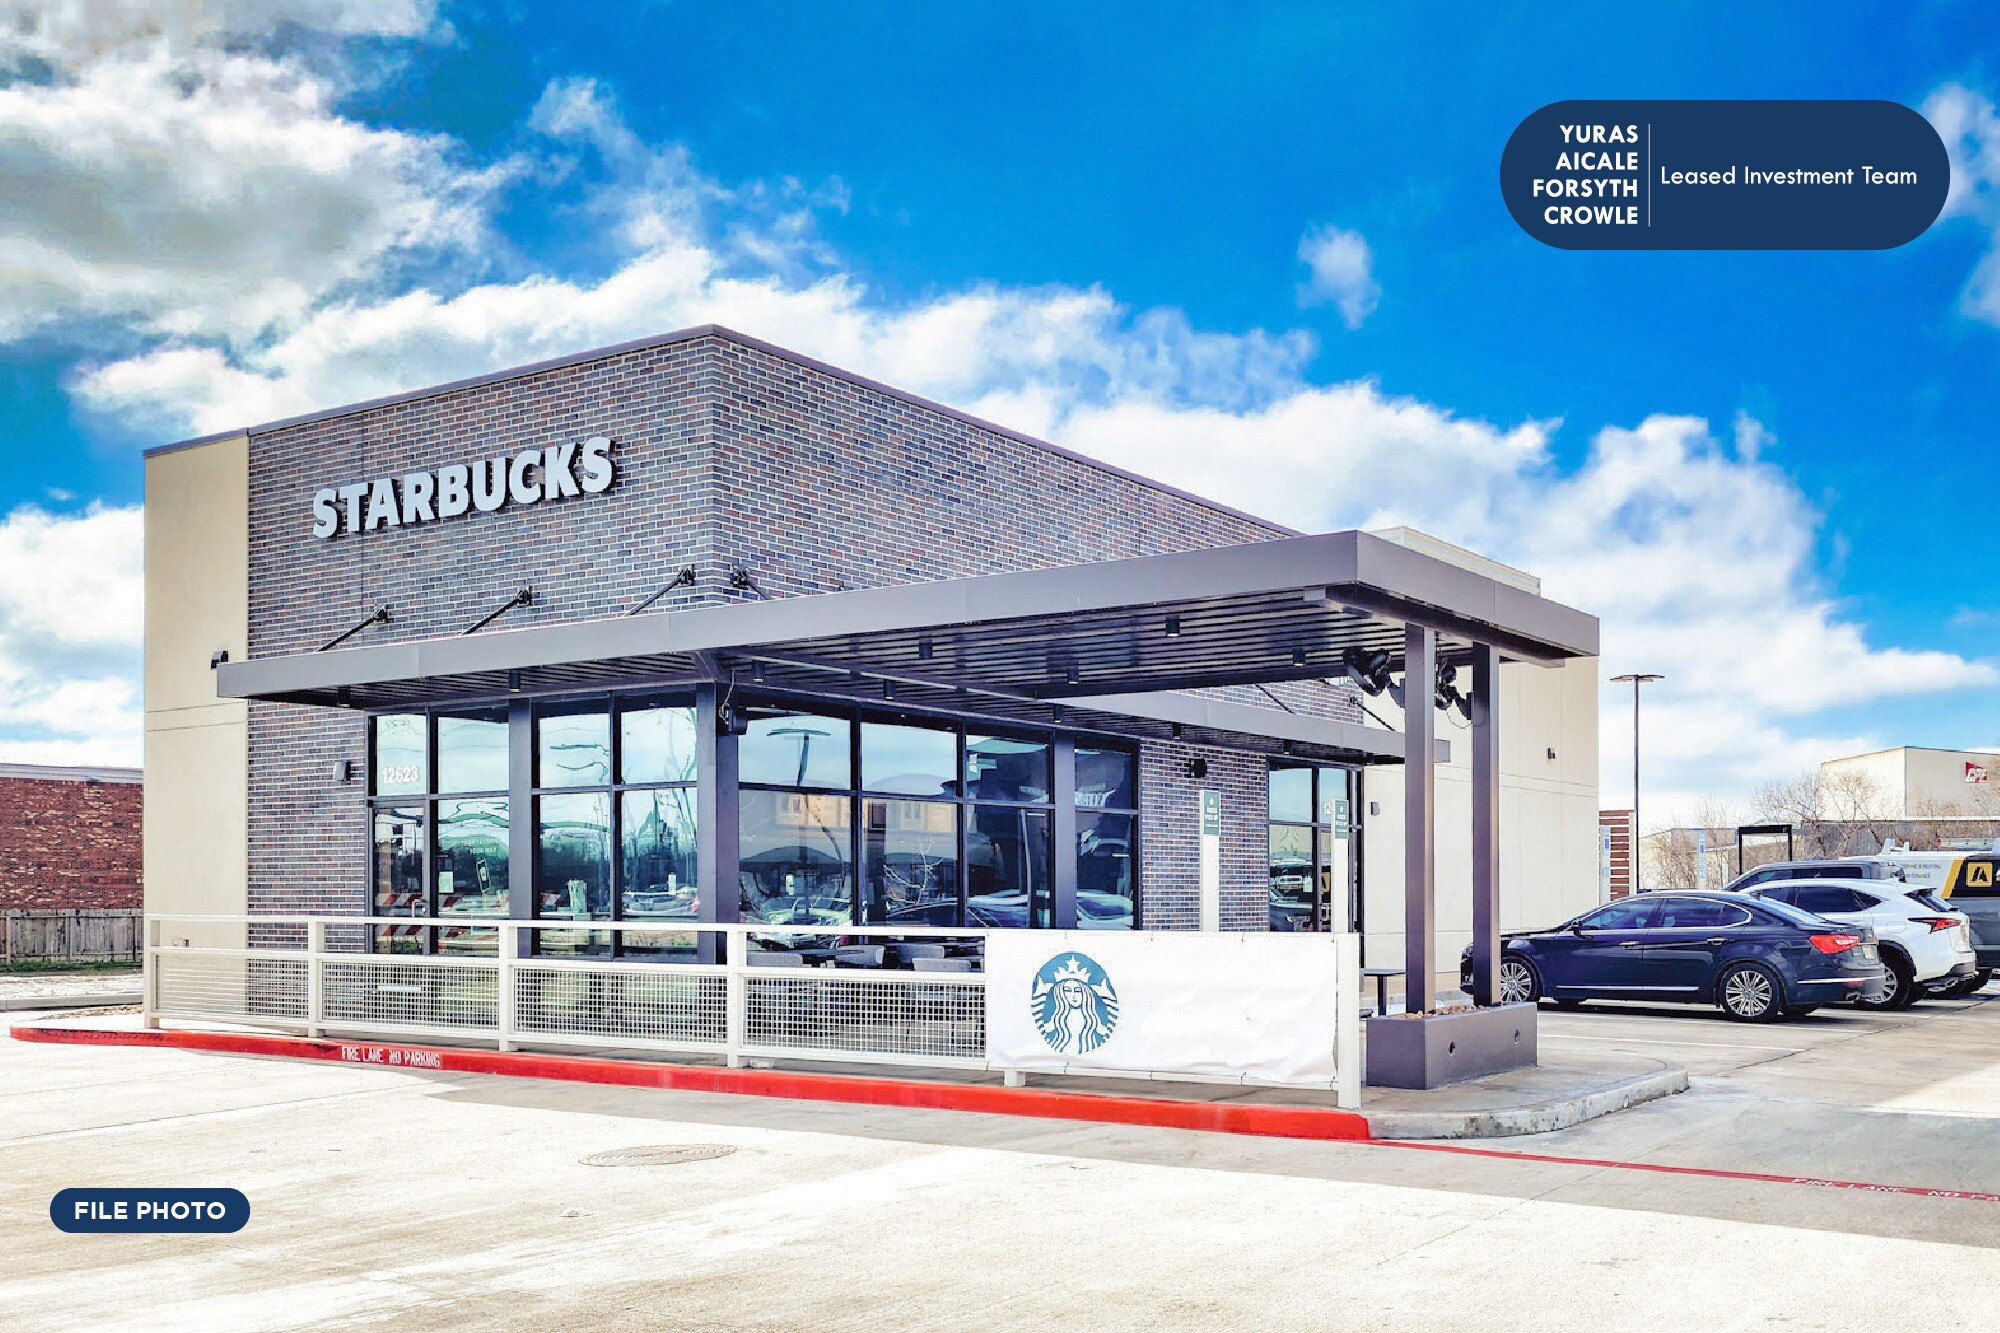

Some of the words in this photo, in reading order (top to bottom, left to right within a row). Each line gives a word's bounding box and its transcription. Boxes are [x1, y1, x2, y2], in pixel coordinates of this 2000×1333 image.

[312, 436, 613, 539] STARBUCKS
[382, 766, 418, 783] 12623
[341, 1046, 360, 1061] FIRE
[362, 1047, 384, 1063] LANE
[389, 1048, 402, 1064] NO
[404, 1050, 440, 1068] PARKING
